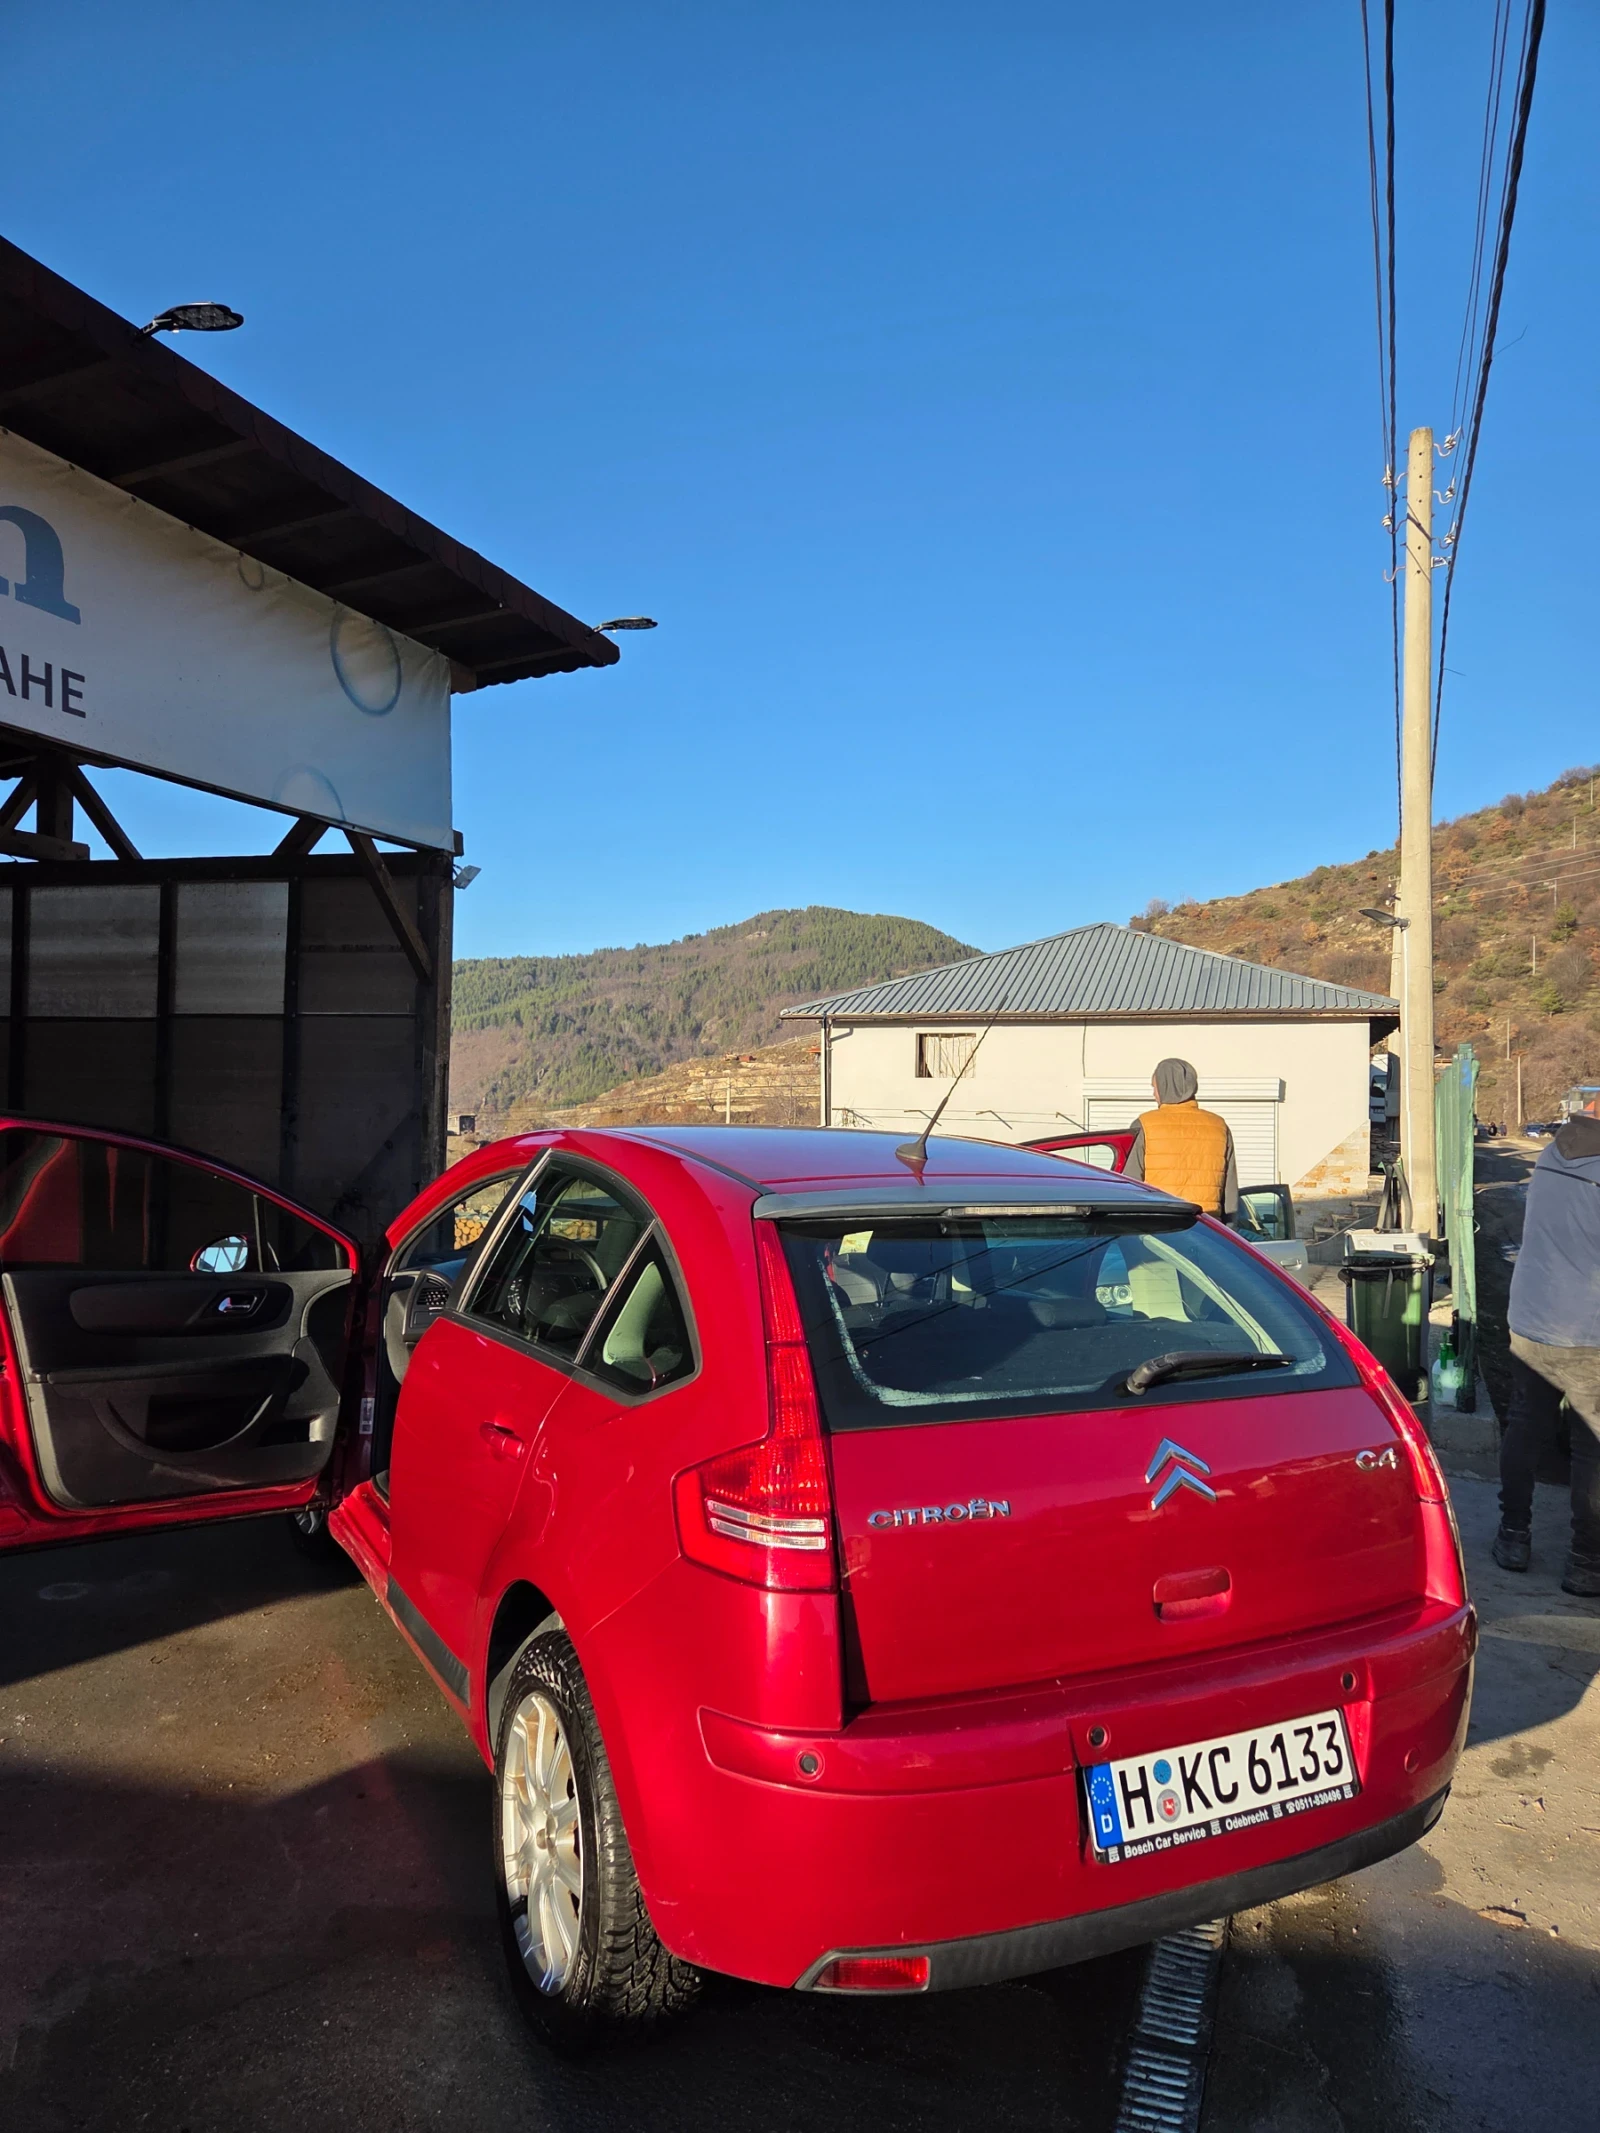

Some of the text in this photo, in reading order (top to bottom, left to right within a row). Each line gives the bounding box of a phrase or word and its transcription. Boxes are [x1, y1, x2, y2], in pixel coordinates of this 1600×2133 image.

[1355, 1447, 1399, 1471] C4
[867, 1498, 1010, 1529] CITROËN
[1118, 1720, 1344, 1830] H KC 6133
[1101, 1813, 1114, 1833] D
[1124, 1839, 1154, 1859] Bosch
[1155, 1836, 1172, 1850] Car
[1173, 1827, 1207, 1845] Service
[1225, 1809, 1270, 1831] Odebrecht
